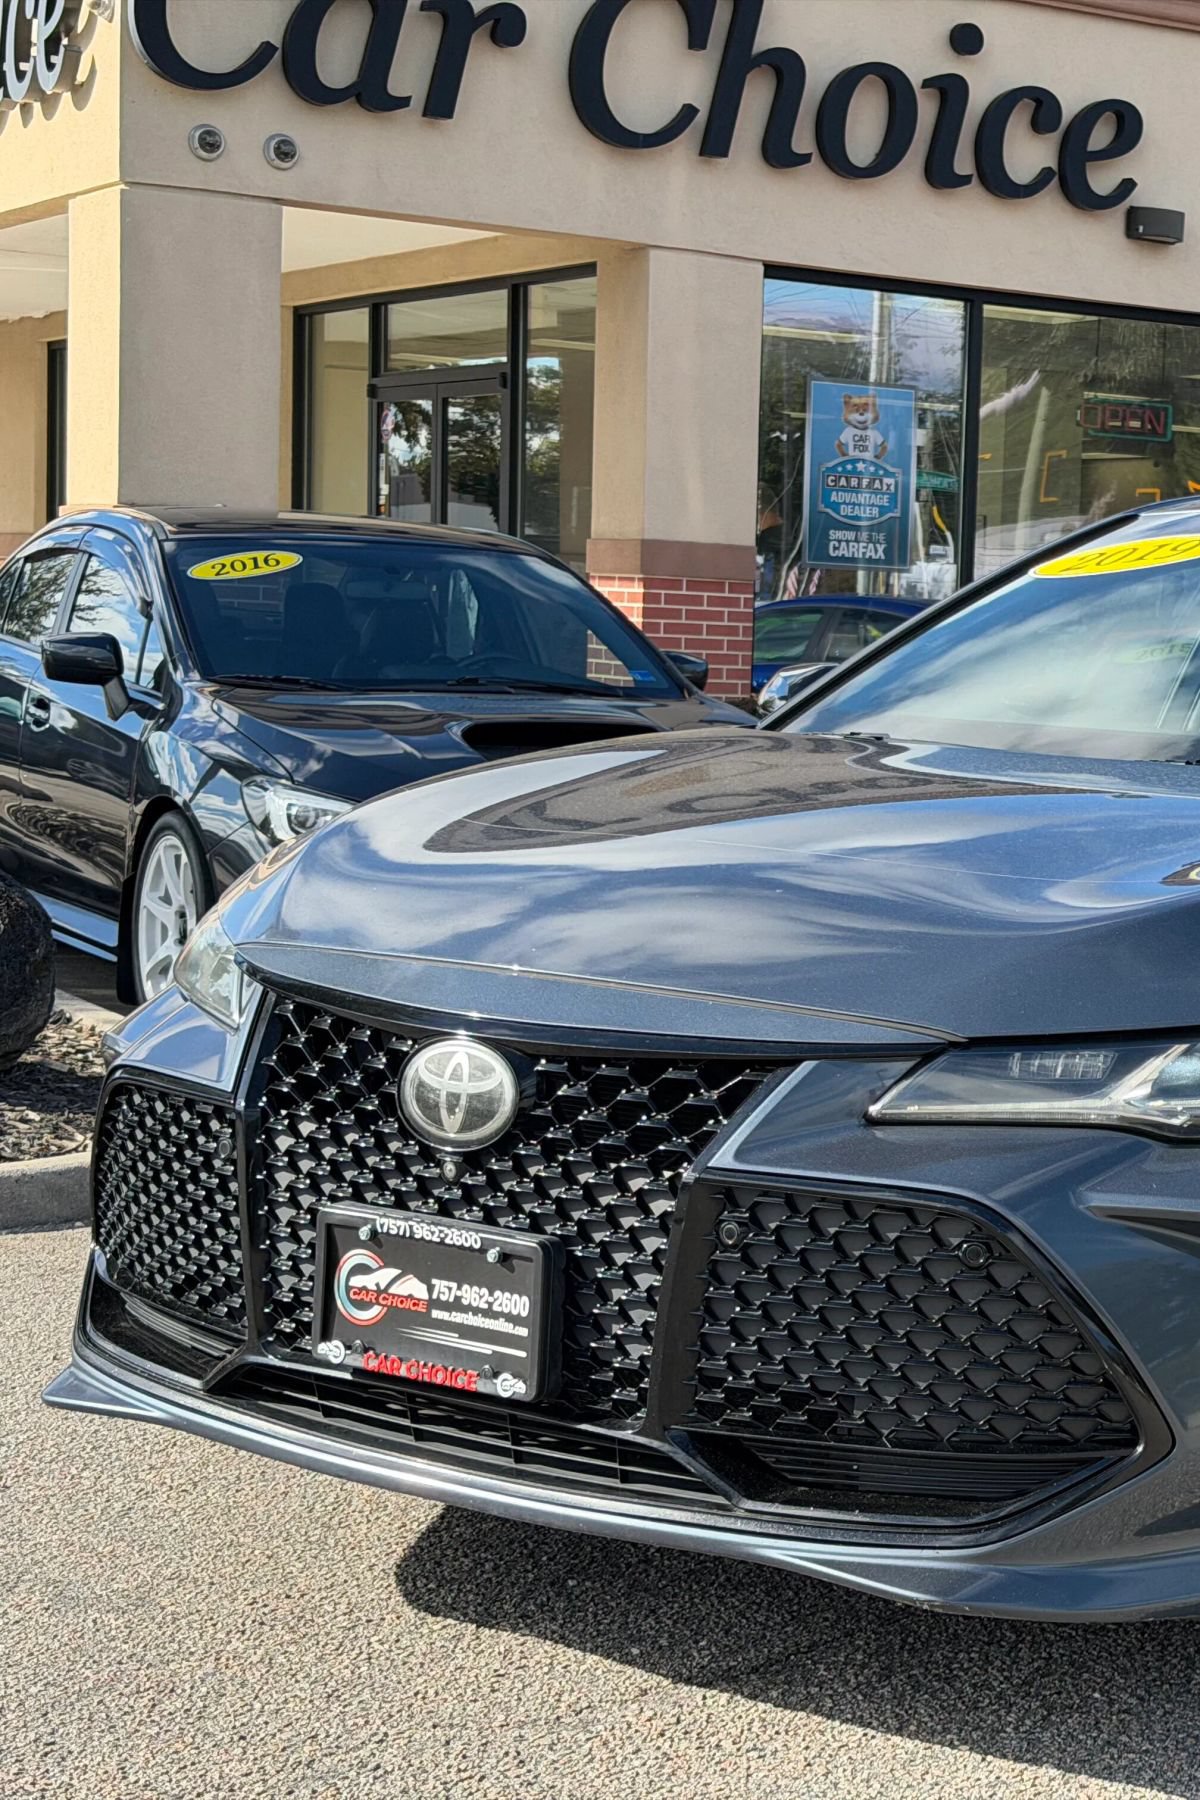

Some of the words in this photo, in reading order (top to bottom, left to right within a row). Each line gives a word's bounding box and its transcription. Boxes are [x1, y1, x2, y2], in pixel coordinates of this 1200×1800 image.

[130, 0, 528, 121] Car
[567, 0, 1144, 212] Choice
[1080, 403, 1166, 434] OPEN
[852, 443, 871, 453] FOX
[825, 475, 895, 492] CARFAX
[830, 491, 890, 506] ADVANTAGE
[840, 505, 879, 518] DEALER
[828, 529, 856, 541] SHOW
[857, 531, 870, 542] ME
[871, 533, 886, 543] THE
[828, 541, 886, 560] CARFAX
[210, 553, 281, 576] 2016
[412, 1222, 482, 1250] 962-2600
[349, 1288, 378, 1304] CAR
[378, 1293, 429, 1314] CHOICE
[431, 1278, 530, 1318] 757-962-2600
[431, 1308, 529, 1337] www.carchoiceonline.com
[363, 1351, 401, 1377] CAR
[405, 1359, 480, 1393] CHOICE
